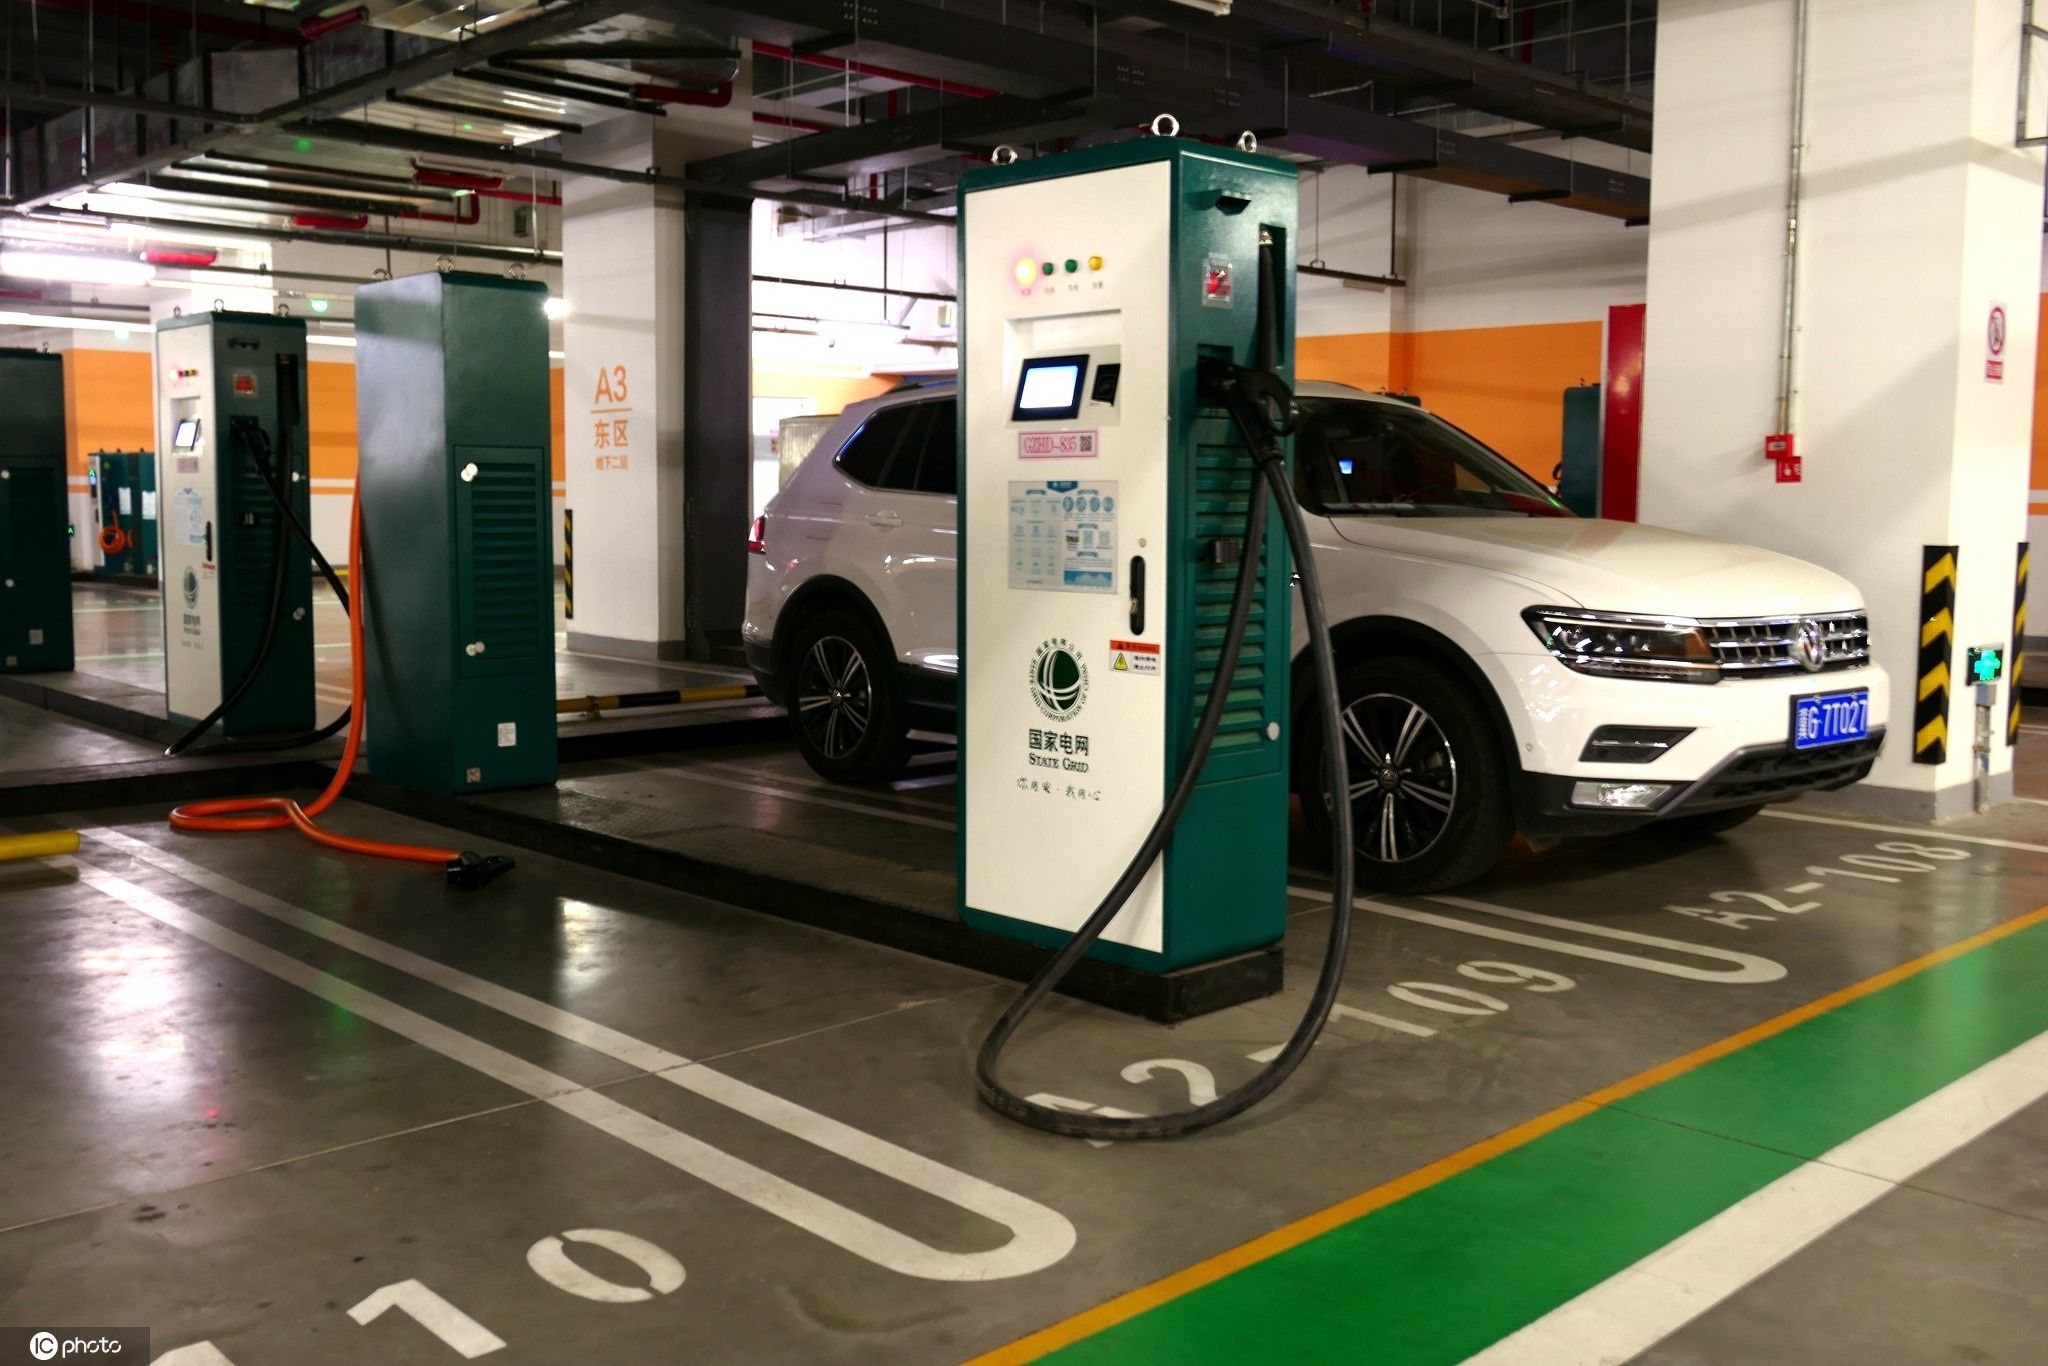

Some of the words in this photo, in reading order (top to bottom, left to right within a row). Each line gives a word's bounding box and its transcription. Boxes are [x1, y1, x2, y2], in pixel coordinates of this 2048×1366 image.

[593, 364, 628, 404] A3
[593, 418, 629, 448] 东区
[1029, 729, 1089, 756] 国家电网
[1662, 842, 1972, 930] A2-108
